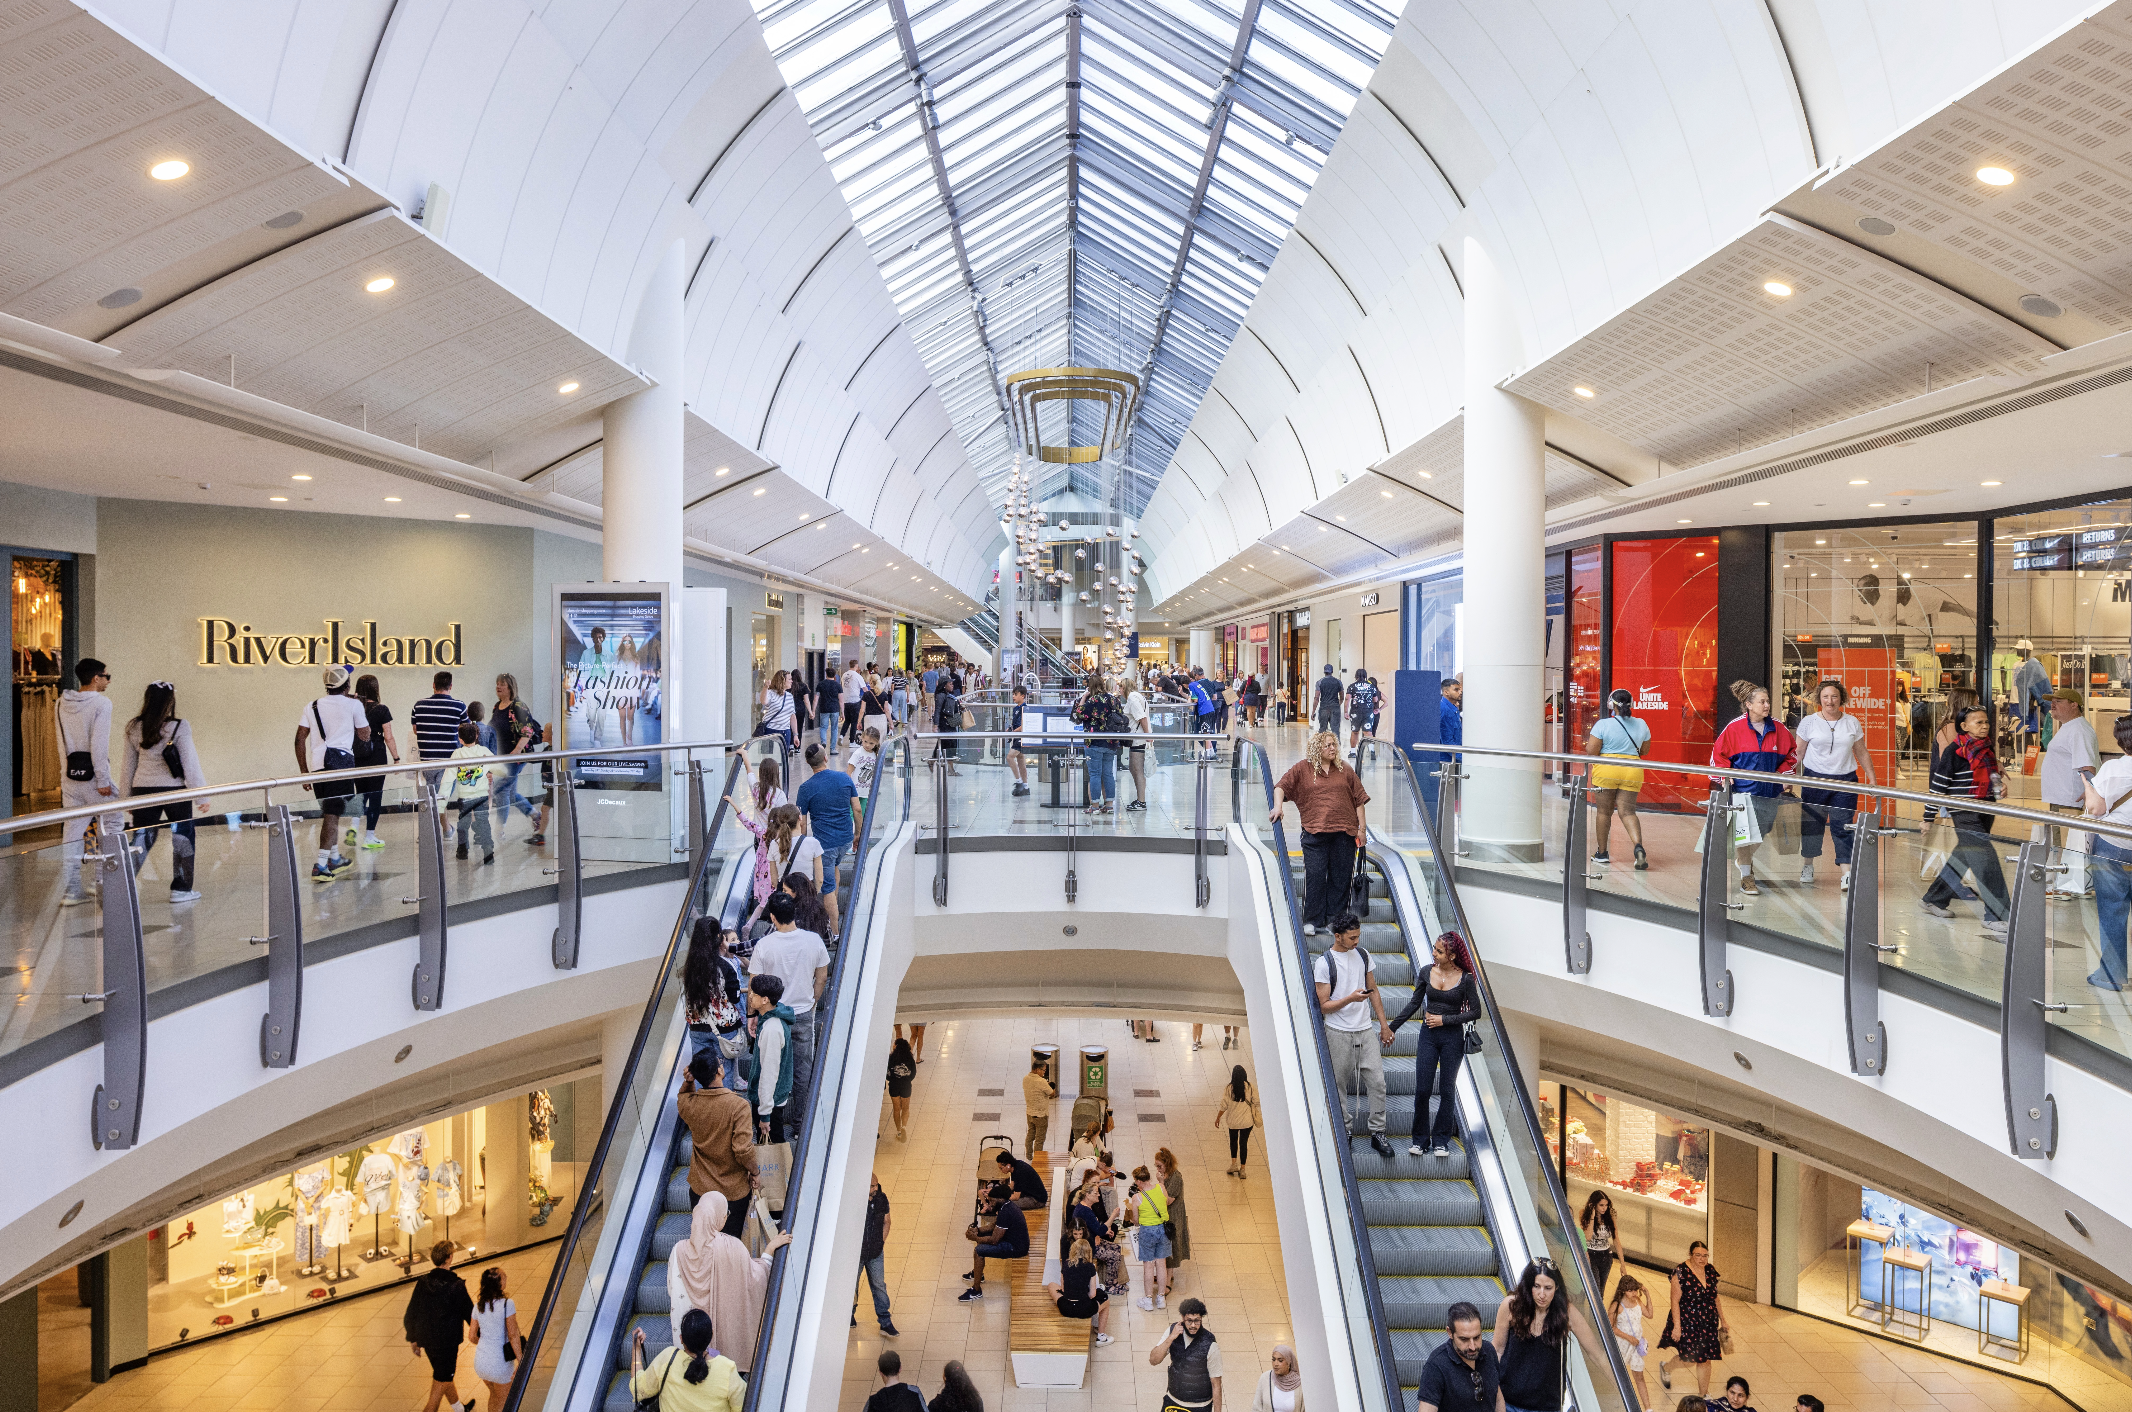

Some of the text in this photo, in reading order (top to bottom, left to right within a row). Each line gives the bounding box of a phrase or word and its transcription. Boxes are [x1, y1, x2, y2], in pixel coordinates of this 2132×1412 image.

[2083, 530, 2115, 543] RETURNS
[628, 607, 658, 615] Lakeside
[574, 669, 652, 690] Fashion
[1640, 692, 1662, 702] UNITE
[1851, 686, 1872, 698] OFF
[589, 690, 641, 710] Show
[1633, 701, 1669, 710] LAKESIDE
